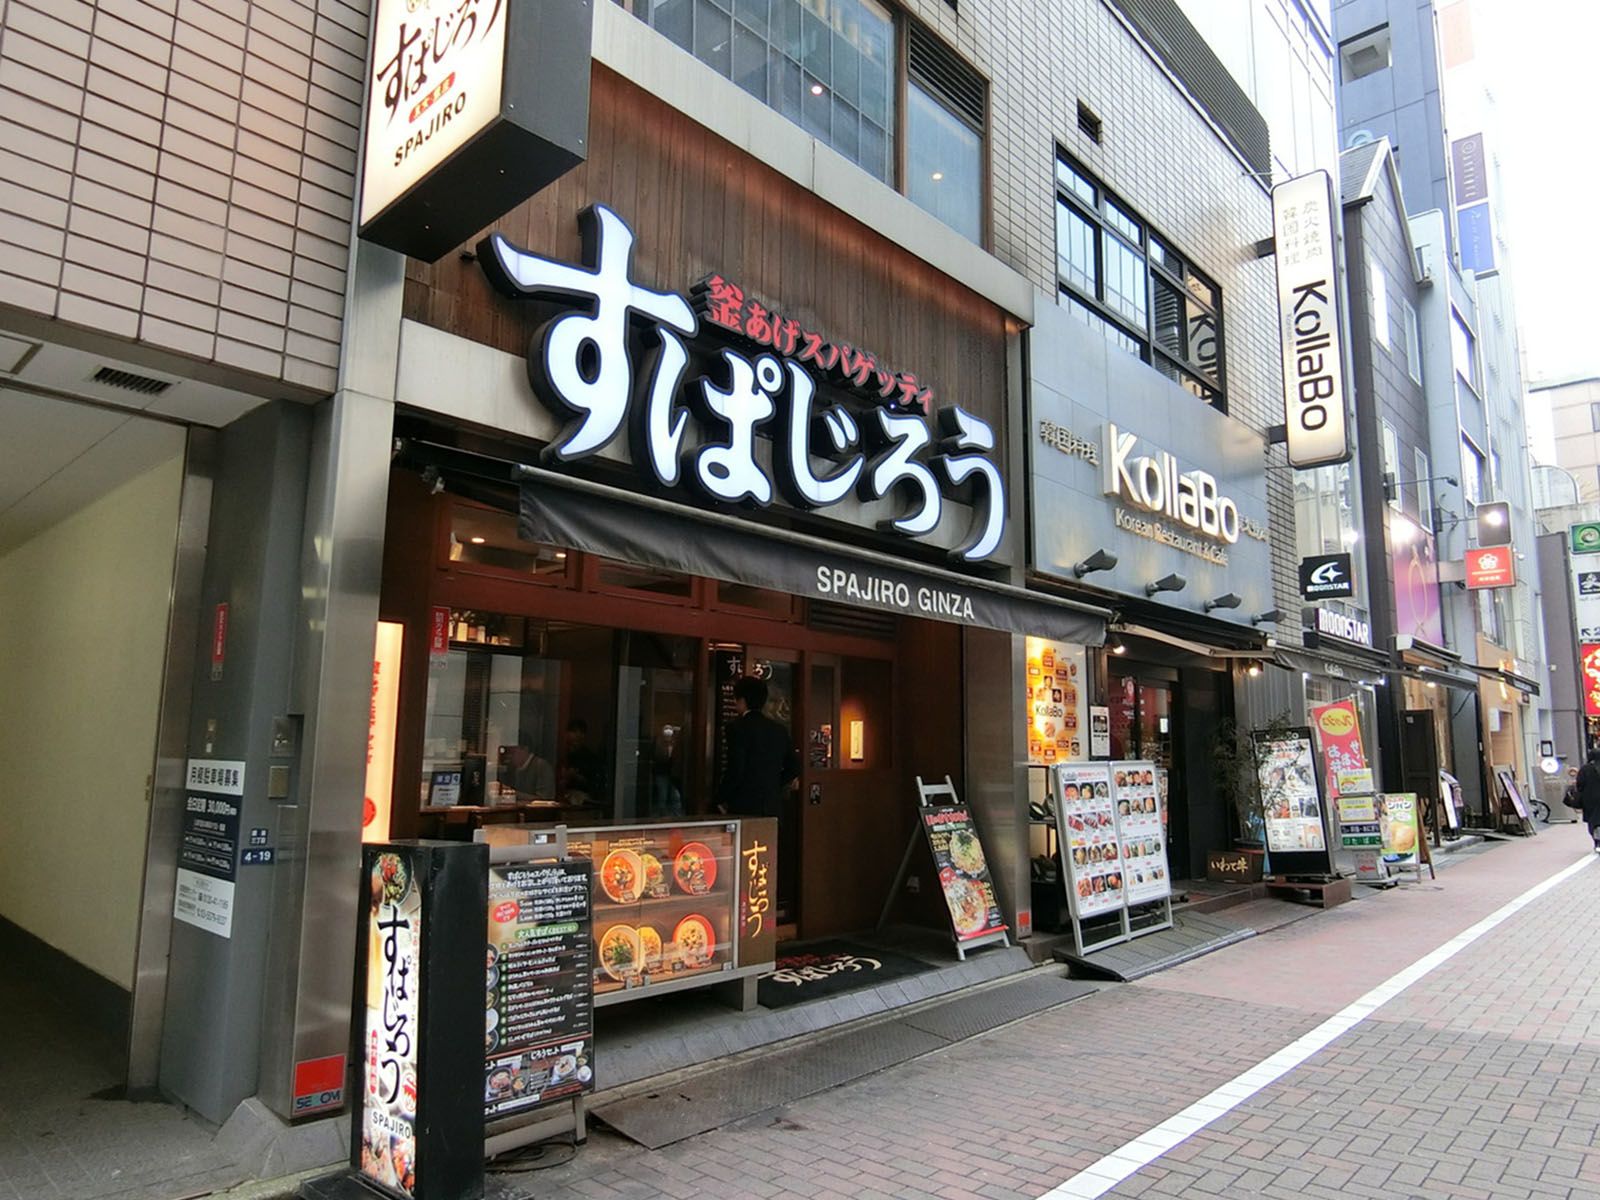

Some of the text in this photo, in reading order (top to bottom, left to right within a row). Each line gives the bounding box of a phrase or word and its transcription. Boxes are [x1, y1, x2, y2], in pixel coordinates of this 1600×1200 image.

[394, 92, 466, 167] SPAJIRO
[707, 274, 935, 413] 釜あげスパゲッティ
[1293, 280, 1334, 431] KollaBo
[493, 203, 1006, 562] すぱじろう
[1102, 422, 1239, 544] KollaBo
[1115, 507, 1154, 538] Korean
[1154, 522, 1203, 556] Restaurant
[816, 566, 975, 619] SPAJIRO GINZA
[1307, 582, 1350, 593] MOONSTAR
[1318, 607, 1370, 645] MOONSTAR
[1035, 705, 1063, 718] KollaBo
[244, 851, 271, 861] 4-19
[1210, 857, 1249, 877] いわて牛
[742, 840, 769, 937] すぱじろう
[377, 905, 411, 1104] すぱじろう
[296, 1097, 341, 1110] SEOM
[371, 1111, 412, 1140] SPAJIRO
